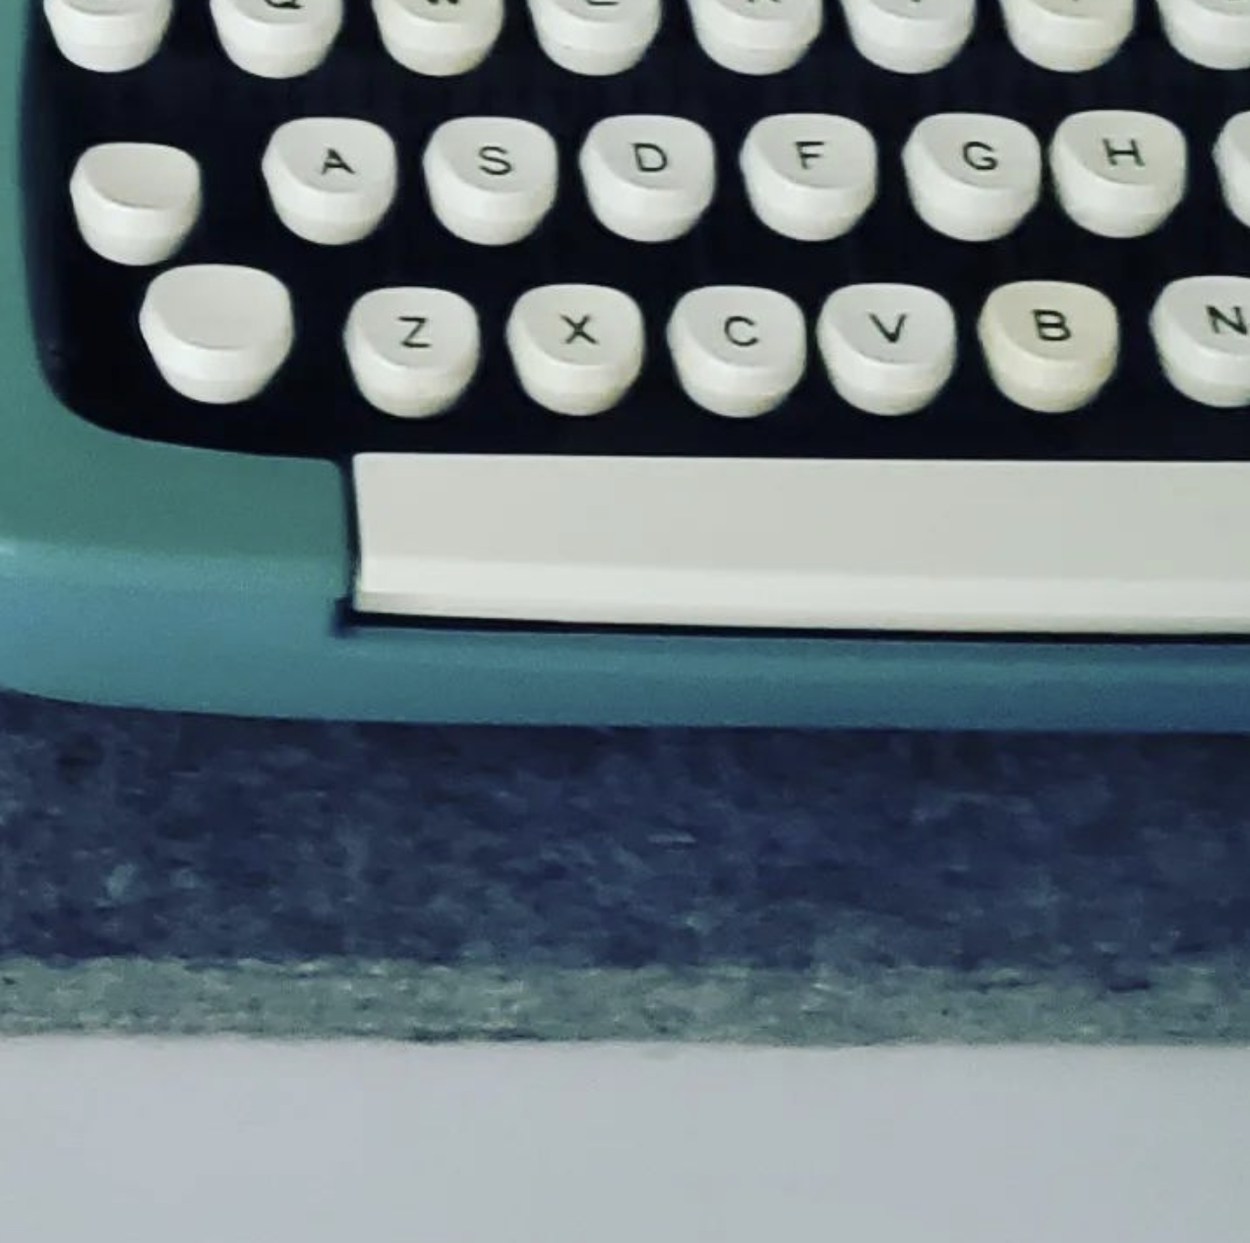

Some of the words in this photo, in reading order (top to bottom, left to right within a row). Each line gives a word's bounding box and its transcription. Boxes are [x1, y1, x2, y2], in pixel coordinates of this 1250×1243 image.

[321, 148, 356, 175] A
[478, 145, 513, 176] S
[631, 142, 669, 173] D
[794, 140, 825, 170] F
[962, 140, 999, 171] G
[1102, 138, 1145, 167] H
[398, 316, 431, 349] Z
[561, 315, 598, 345] X
[723, 315, 759, 347] C
[869, 314, 907, 344] V
[1032, 308, 1072, 342] B
[1205, 305, 1249, 336] N
